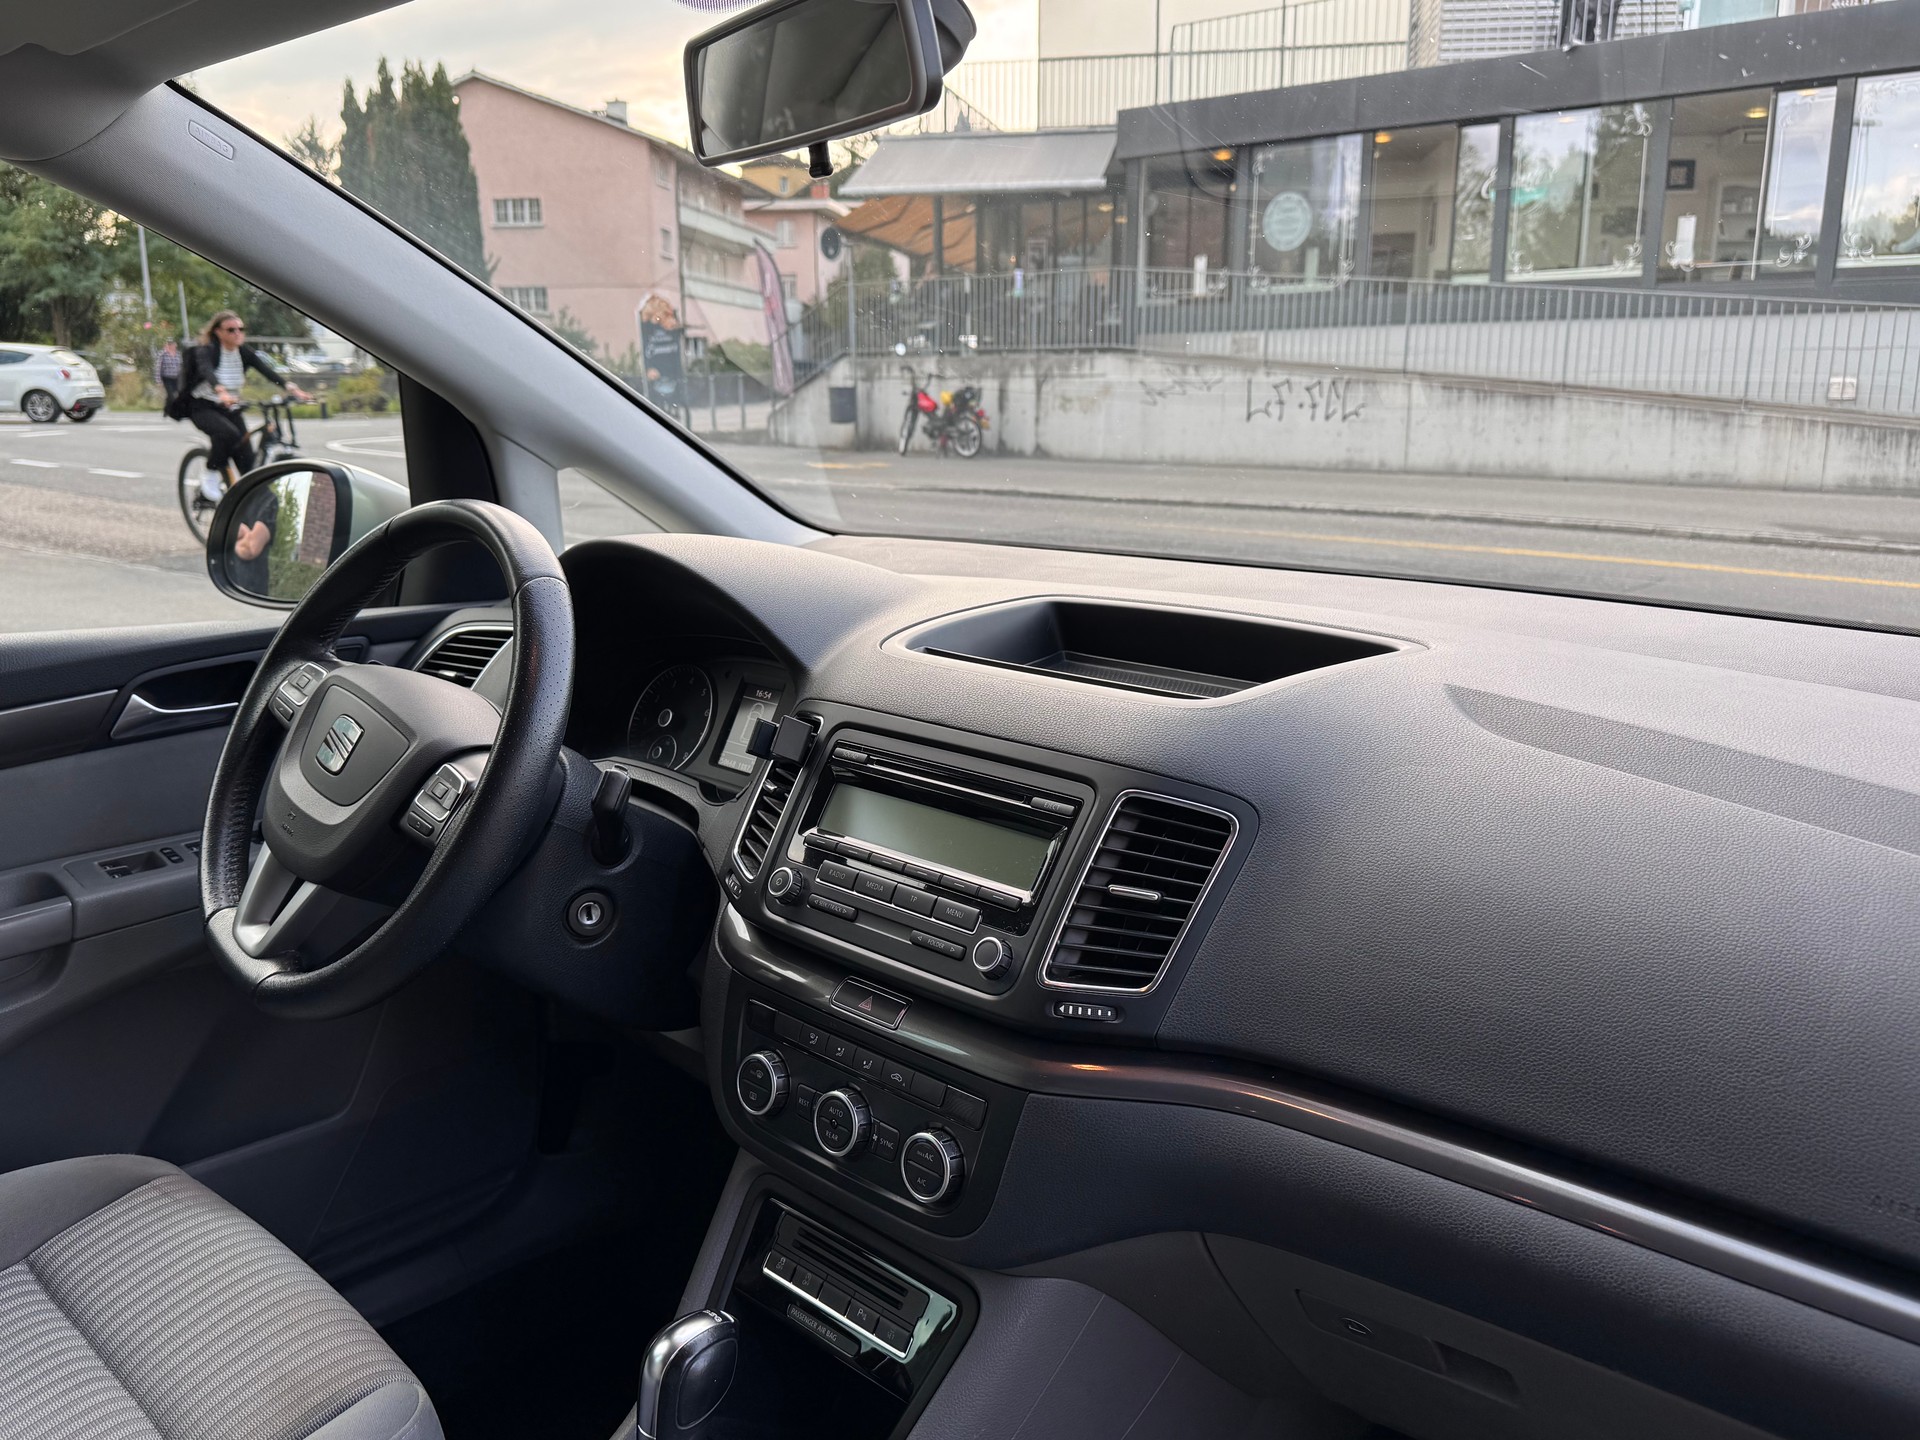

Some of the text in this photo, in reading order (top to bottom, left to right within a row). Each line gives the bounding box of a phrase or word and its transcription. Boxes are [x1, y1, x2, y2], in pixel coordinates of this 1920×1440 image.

[755, 689, 773, 699] 16:54
[828, 869, 846, 880] RADIO
[866, 880, 885, 892] MEDIA
[910, 895, 918, 903] TP
[945, 907, 964, 919] MENU
[927, 938, 945, 950] FOLDER
[829, 1106, 844, 1118] AUTO
[825, 1130, 839, 1142] REAR
[879, 1137, 894, 1150] SYNC
[791, 1307, 838, 1342] PASSENGER AIR BAG
